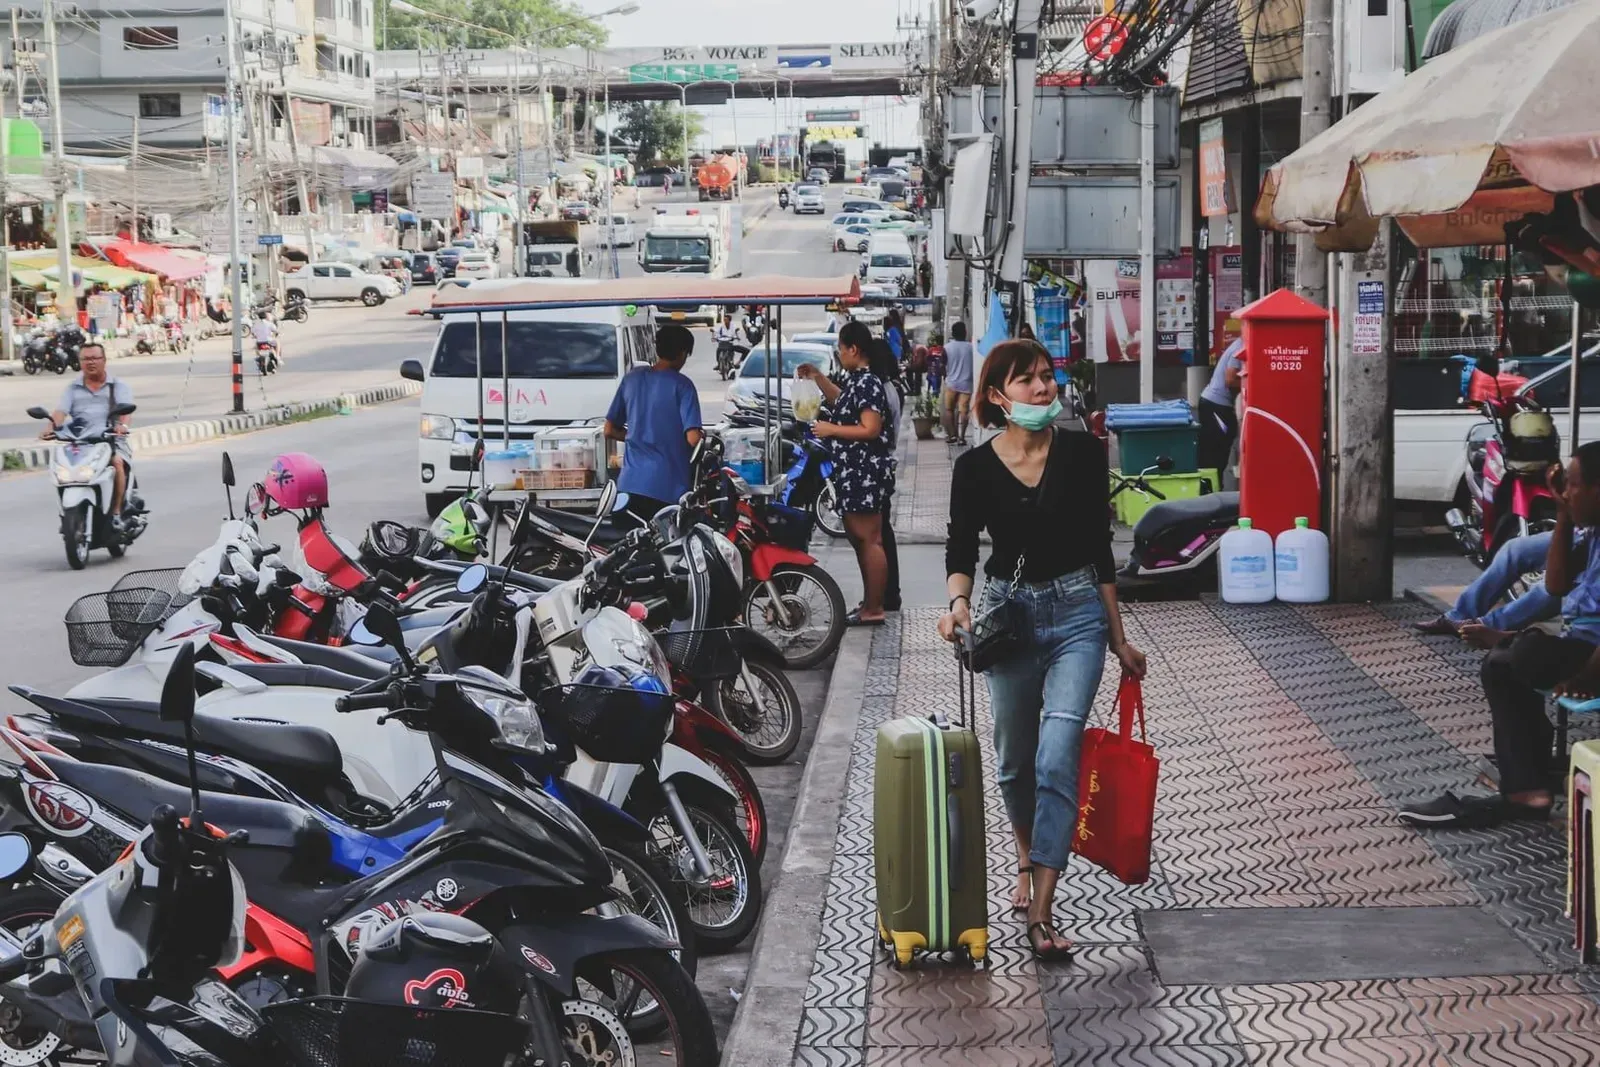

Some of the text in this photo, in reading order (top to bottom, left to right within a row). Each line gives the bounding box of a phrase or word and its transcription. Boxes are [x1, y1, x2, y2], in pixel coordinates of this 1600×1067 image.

[706, 47, 768, 60] VOYAGE
[1119, 265, 1139, 277] 299
[1270, 361, 1302, 371] 90320
